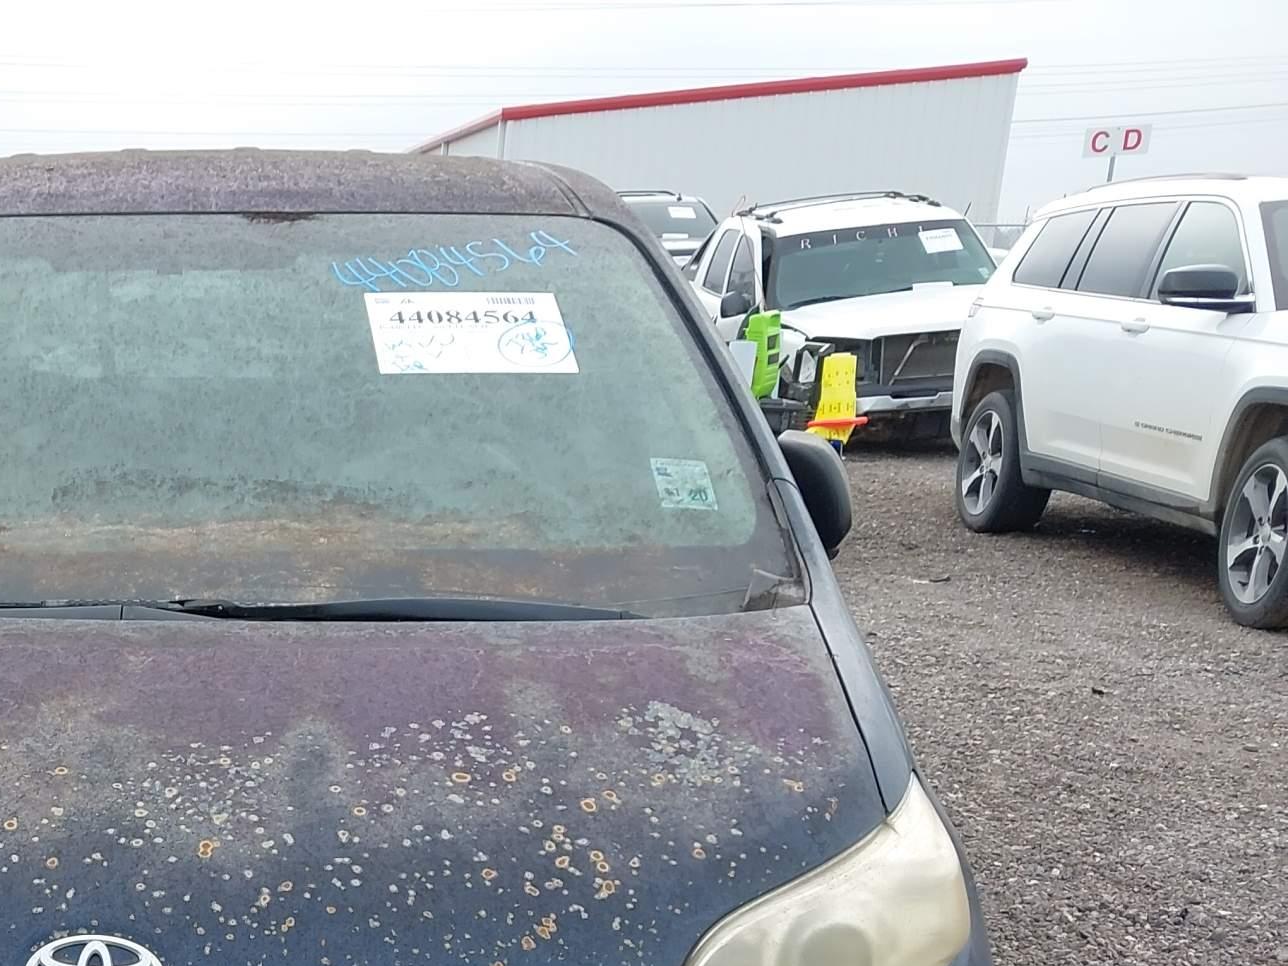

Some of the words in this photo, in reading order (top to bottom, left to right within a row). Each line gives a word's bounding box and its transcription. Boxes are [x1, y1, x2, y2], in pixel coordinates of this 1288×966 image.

[1091, 130, 1110, 153] C
[1122, 128, 1142, 151] D
[332, 230, 578, 291] 44084564
[389, 310, 538, 325] 44084564
